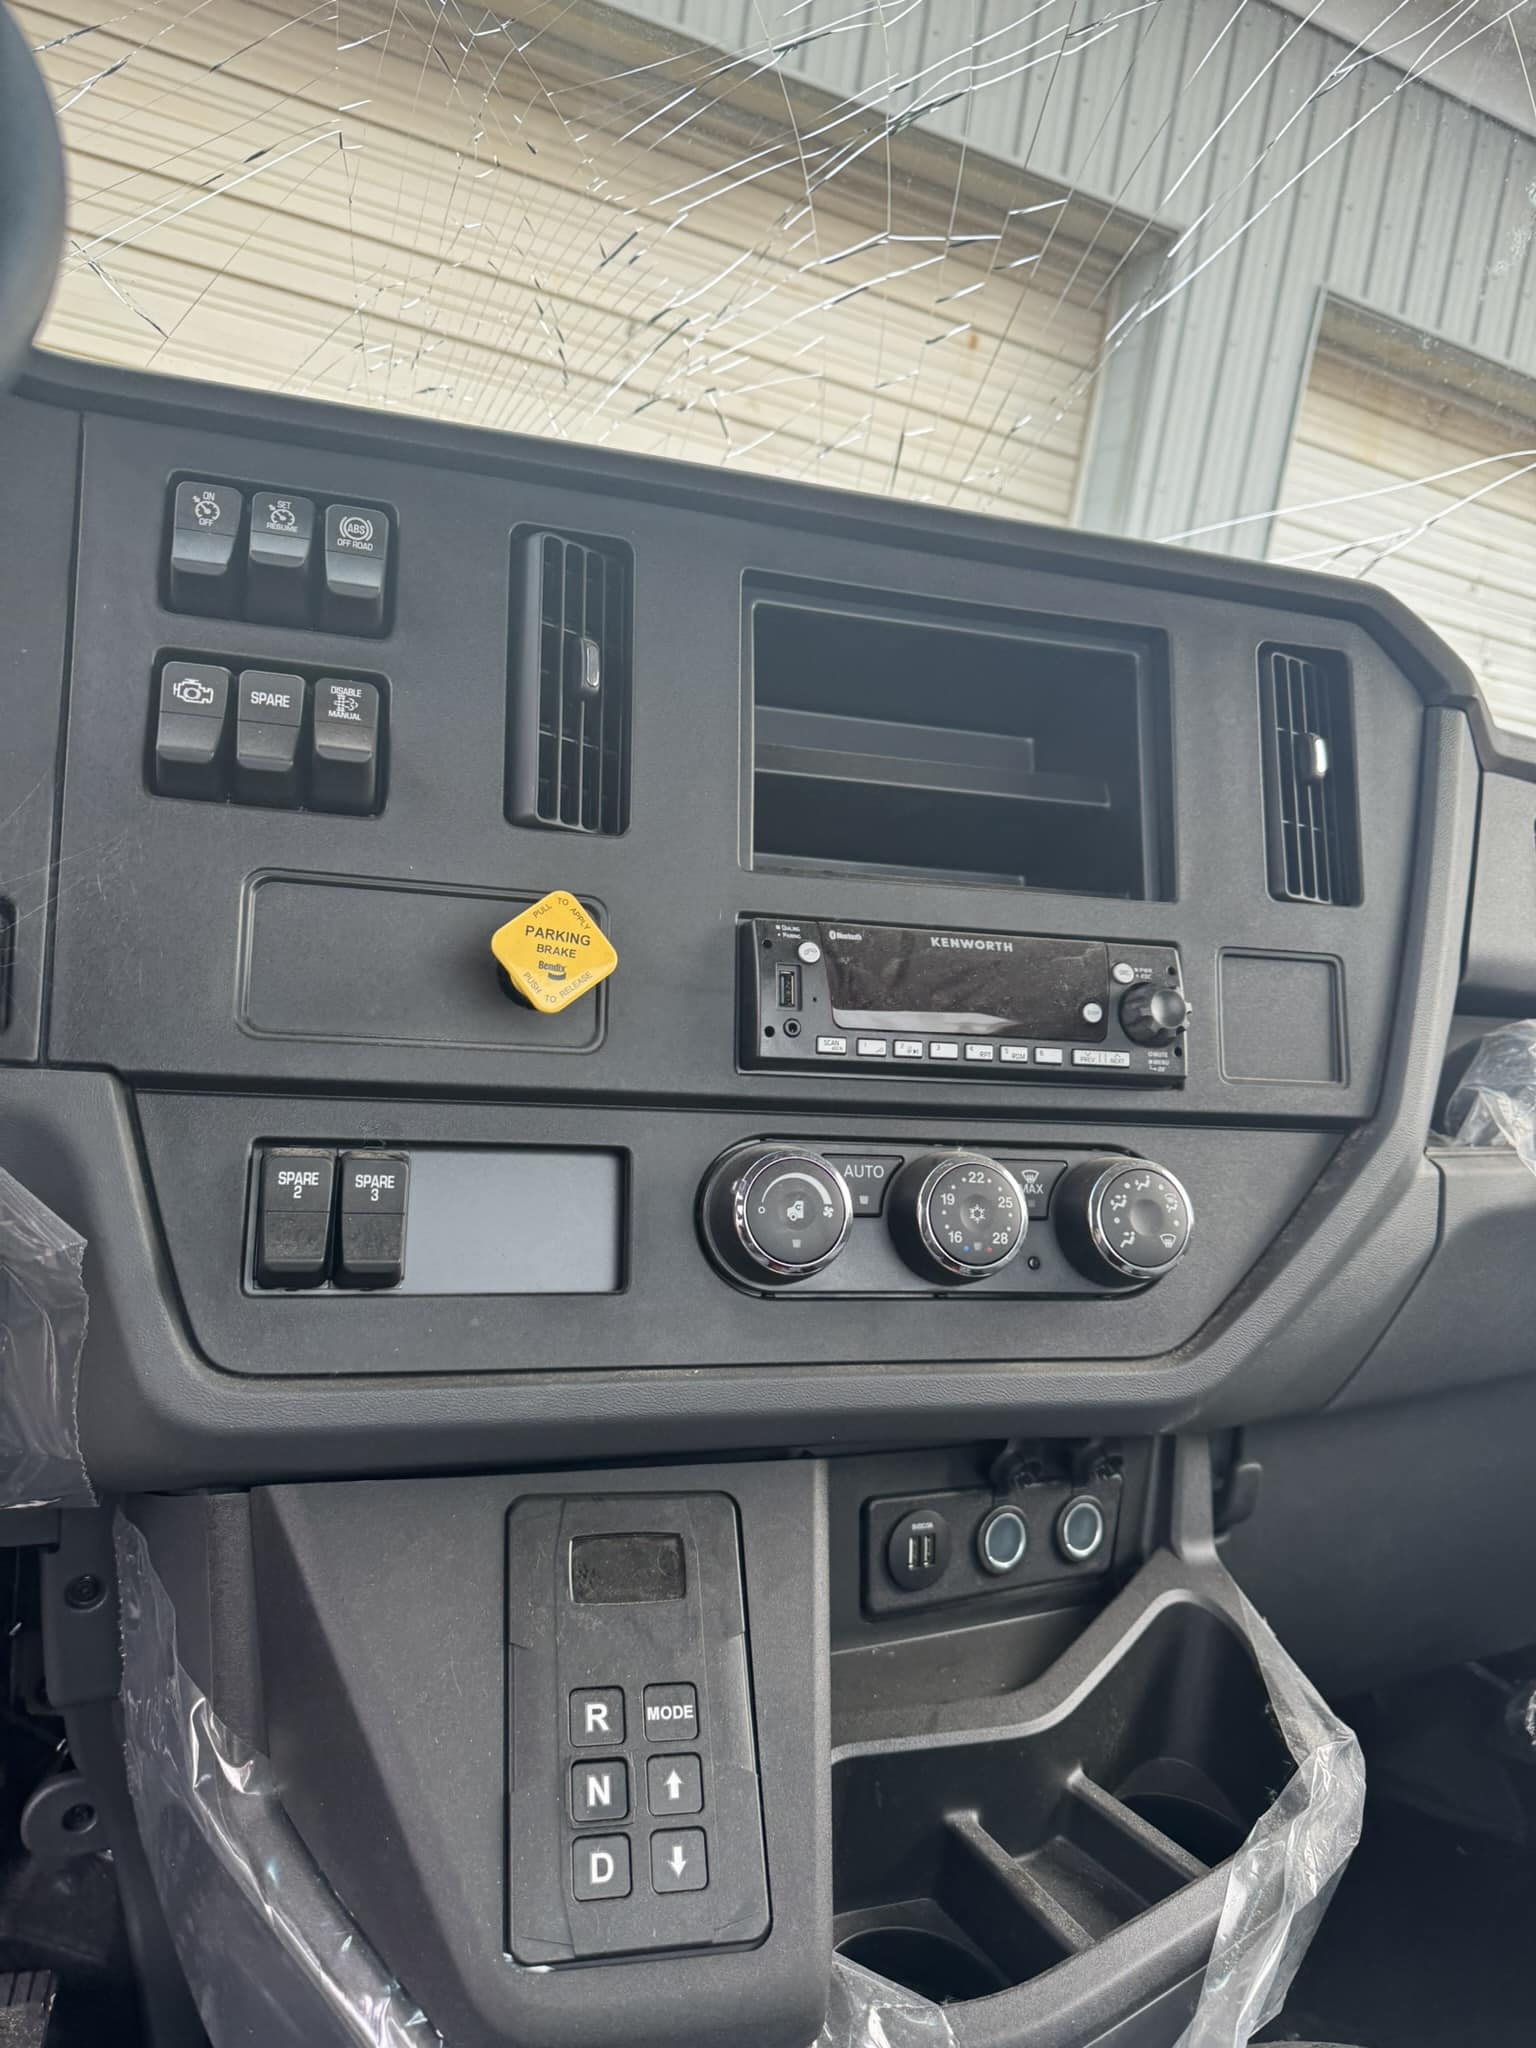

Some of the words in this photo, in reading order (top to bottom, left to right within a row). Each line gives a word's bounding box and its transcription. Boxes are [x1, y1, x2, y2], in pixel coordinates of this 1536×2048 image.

[203, 491, 215, 501] ON
[277, 500, 291, 509] SET
[199, 518, 214, 527] OFF
[347, 523, 366, 535] ABS
[337, 538, 351, 548] OFF
[352, 540, 373, 551] ROAD
[330, 686, 362, 698] DISABLE
[250, 691, 291, 708] SPARE
[328, 709, 361, 721] MANUAL
[532, 903, 552, 919] PULL
[557, 897, 569, 906] TO
[570, 907, 591, 931] APPLY
[525, 925, 591, 946] PARKING
[931, 937, 1014, 952] KENWORTH
[536, 944, 577, 959] BRAKE
[538, 961, 566, 973] Bendix
[523, 972, 542, 994] PUSH
[545, 994, 557, 1003] TO
[559, 971, 593, 999] RELEASE
[843, 1164, 885, 1179] AUTO
[968, 1171, 985, 1184] 22
[278, 1171, 320, 1186] SPARE
[354, 1174, 395, 1189] SPARE
[293, 1186, 303, 1199] 2
[370, 1188, 379, 1201] 3
[940, 1193, 956, 1206] 19
[998, 1196, 1013, 1209] 25
[948, 1231, 963, 1244] 16
[992, 1232, 1009, 1245] 28
[585, 1702, 610, 1733] R
[647, 1704, 694, 1721] MODE
[586, 1775, 611, 1807] N
[589, 1852, 614, 1884] D
